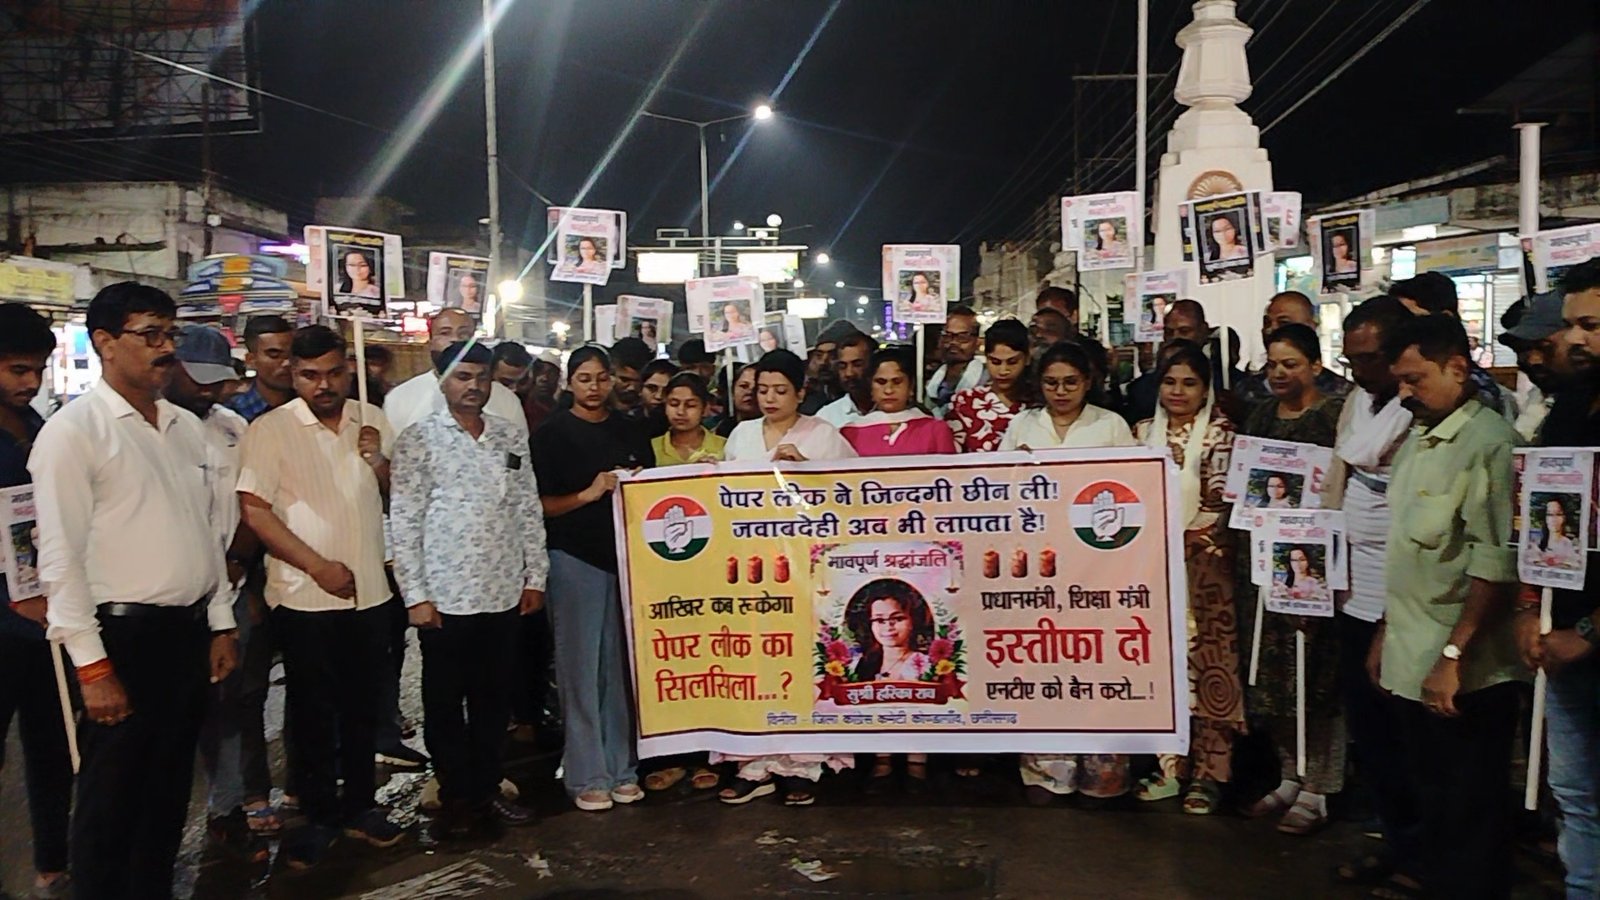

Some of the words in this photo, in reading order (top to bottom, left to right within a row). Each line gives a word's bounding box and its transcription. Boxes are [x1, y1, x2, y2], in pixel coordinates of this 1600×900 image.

[719, 485, 764, 508] पेपर
[835, 482, 852, 505] ने
[861, 478, 953, 505] जिन्दगी
[962, 476, 1010, 501] छीन
[1019, 475, 1058, 500] ली!
[732, 512, 839, 538] जवाबदेही
[849, 518, 888, 535] अब
[898, 510, 926, 534] भी
[935, 515, 1011, 534] लापता
[1018, 507, 1045, 533] है!
[828, 550, 879, 573] भावपूर्ण
[883, 549, 947, 569] श्रद्धांजलि
[649, 595, 705, 619] आखिर
[709, 597, 734, 614] कब
[980, 585, 1063, 613] प्रधानमंत्री,
[1068, 584, 1111, 610] शिक्षा
[1116, 584, 1150, 609] मंत्री
[652, 628, 701, 661] पेपर
[708, 625, 752, 658] लीक
[760, 633, 794, 657] का
[983, 617, 1104, 668] इस्तीफा
[1115, 616, 1151, 666] दो
[986, 676, 1035, 700] एनटीए
[1040, 675, 1062, 700] को
[1069, 675, 1093, 700] बैन
